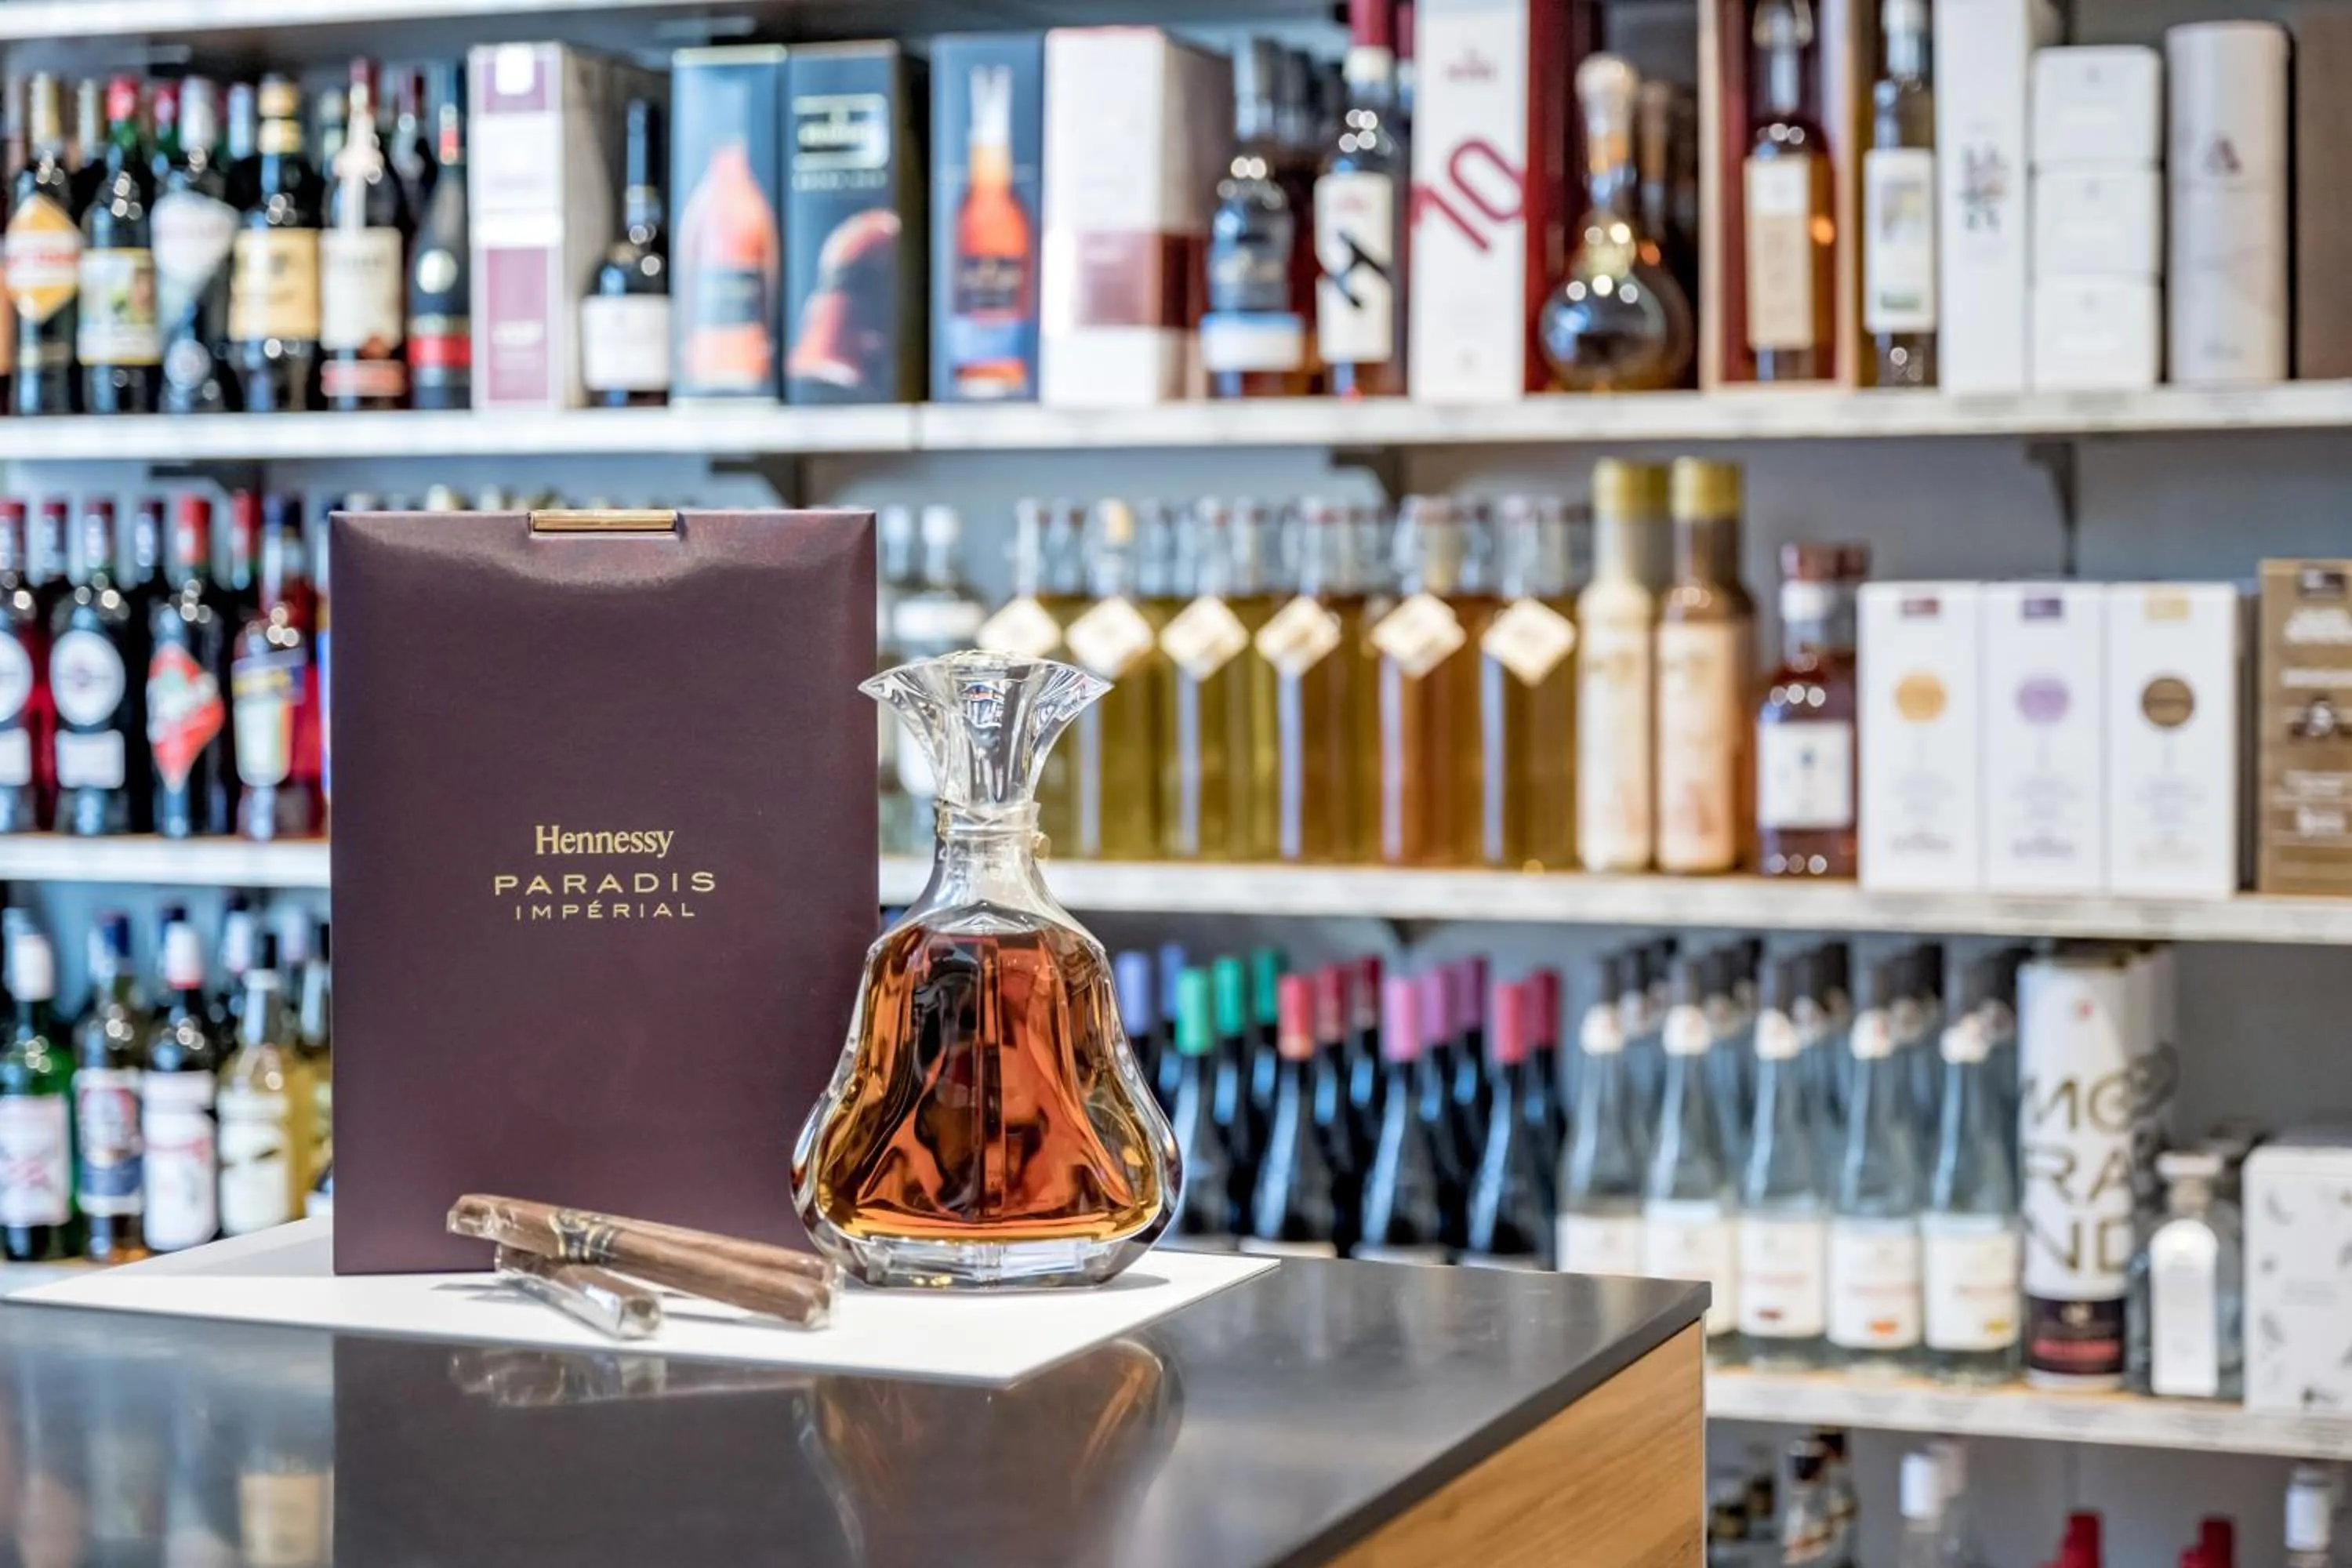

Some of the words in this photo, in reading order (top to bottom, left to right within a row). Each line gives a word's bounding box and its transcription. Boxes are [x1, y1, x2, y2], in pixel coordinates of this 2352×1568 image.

[535, 824, 675, 859] Hennessy
[493, 870, 717, 896] PARADIS
[514, 898, 696, 921] IMPÉRIAL
